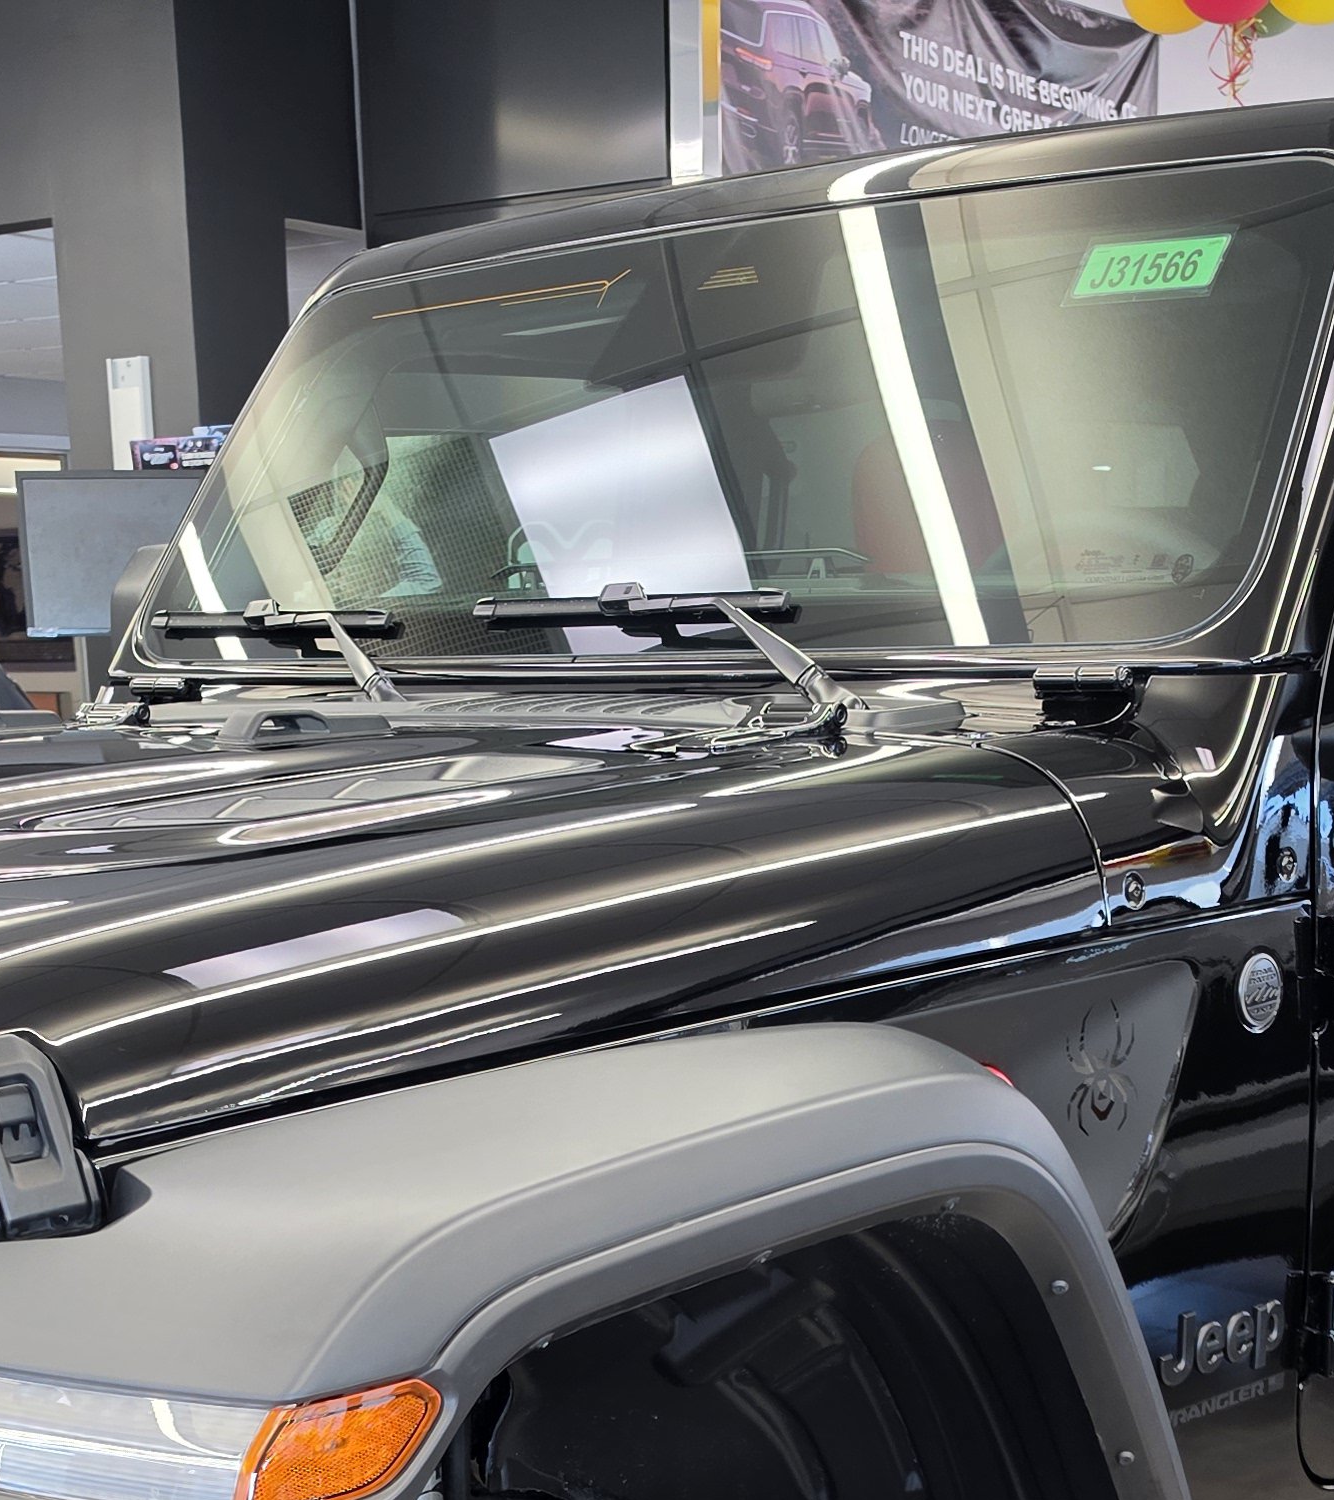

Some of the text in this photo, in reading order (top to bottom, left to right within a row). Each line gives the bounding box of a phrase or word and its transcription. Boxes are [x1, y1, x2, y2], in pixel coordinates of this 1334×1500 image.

[899, 31, 939, 68] THIS
[942, 46, 988, 84] DEAL
[989, 62, 1004, 90] IS
[1006, 68, 1037, 101] THE
[901, 72, 1052, 132] YOUR NEXT GREAT
[1090, 248, 1204, 290] J31566
[1159, 1299, 1285, 1386] Jeep
